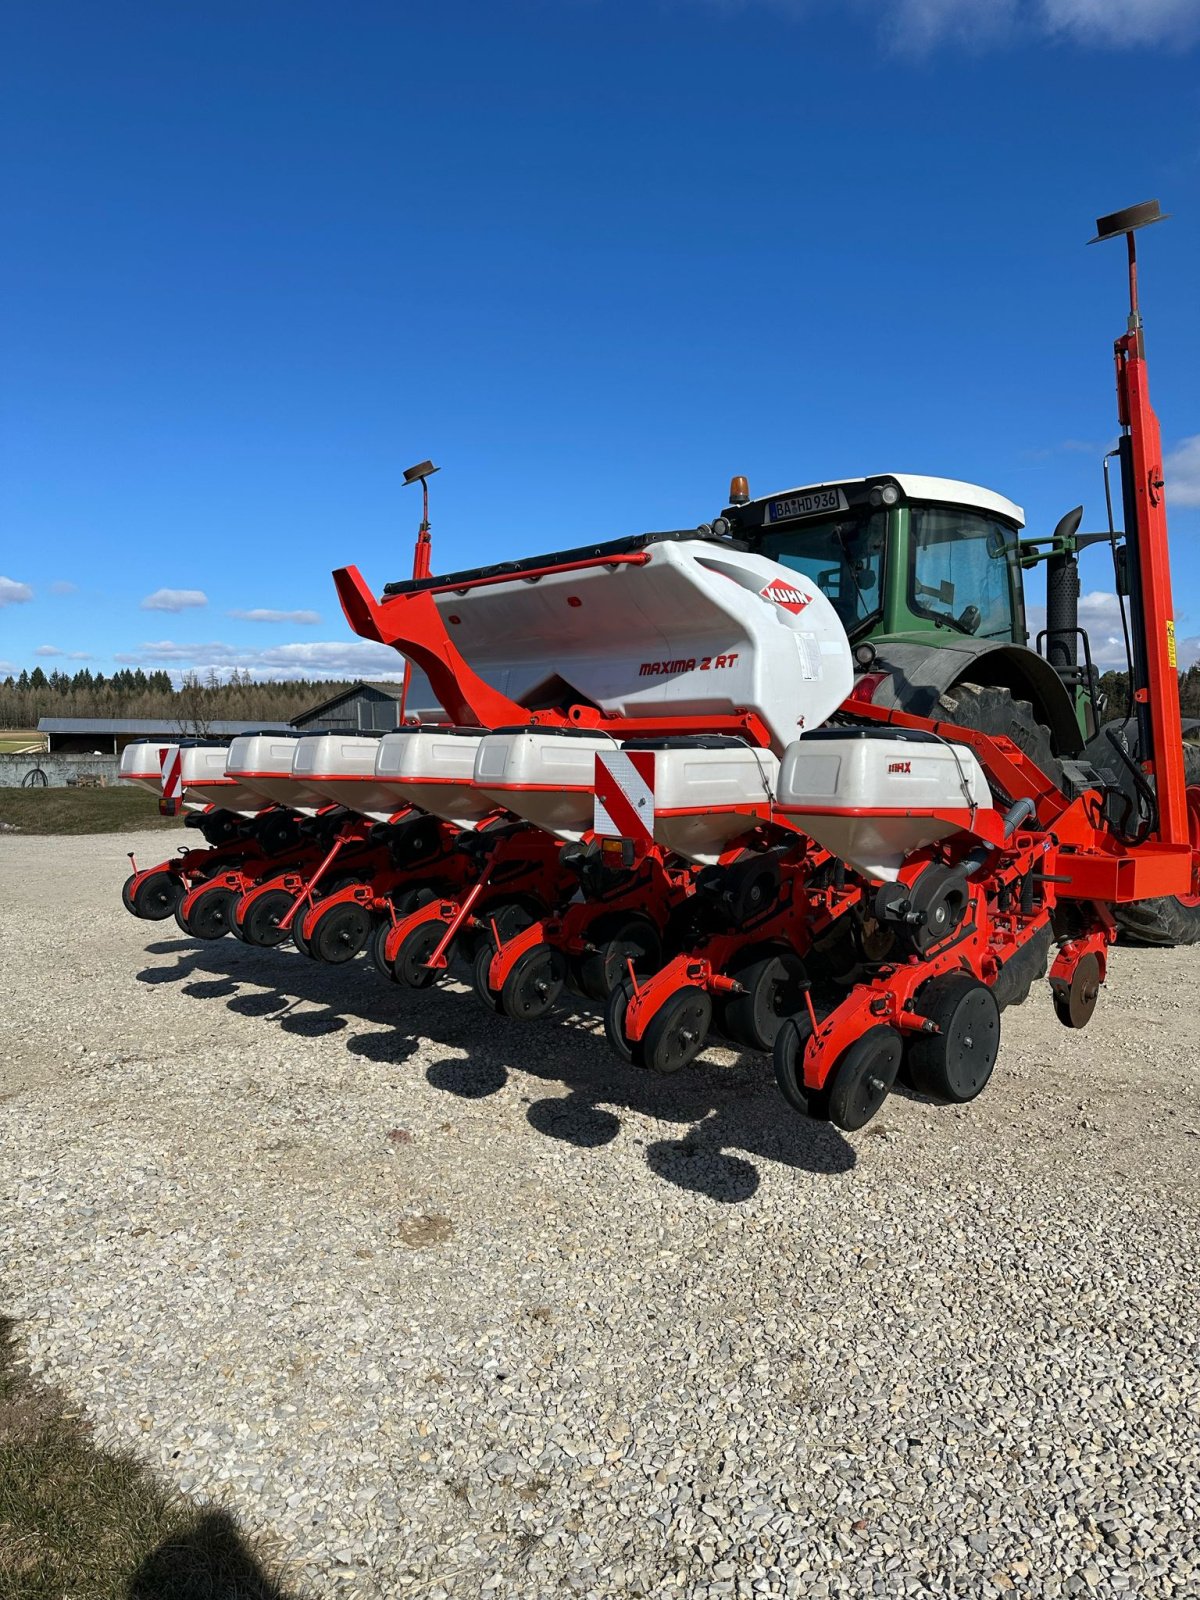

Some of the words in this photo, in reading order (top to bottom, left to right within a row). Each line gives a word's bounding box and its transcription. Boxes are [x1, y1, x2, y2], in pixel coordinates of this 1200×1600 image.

[776, 502, 791, 516] BA
[797, 497, 812, 512] HD
[814, 492, 836, 509] 936
[765, 587, 809, 605] KUHN
[638, 658, 697, 676] MAXIMA
[700, 657, 712, 671] 2
[715, 653, 739, 669] RT
